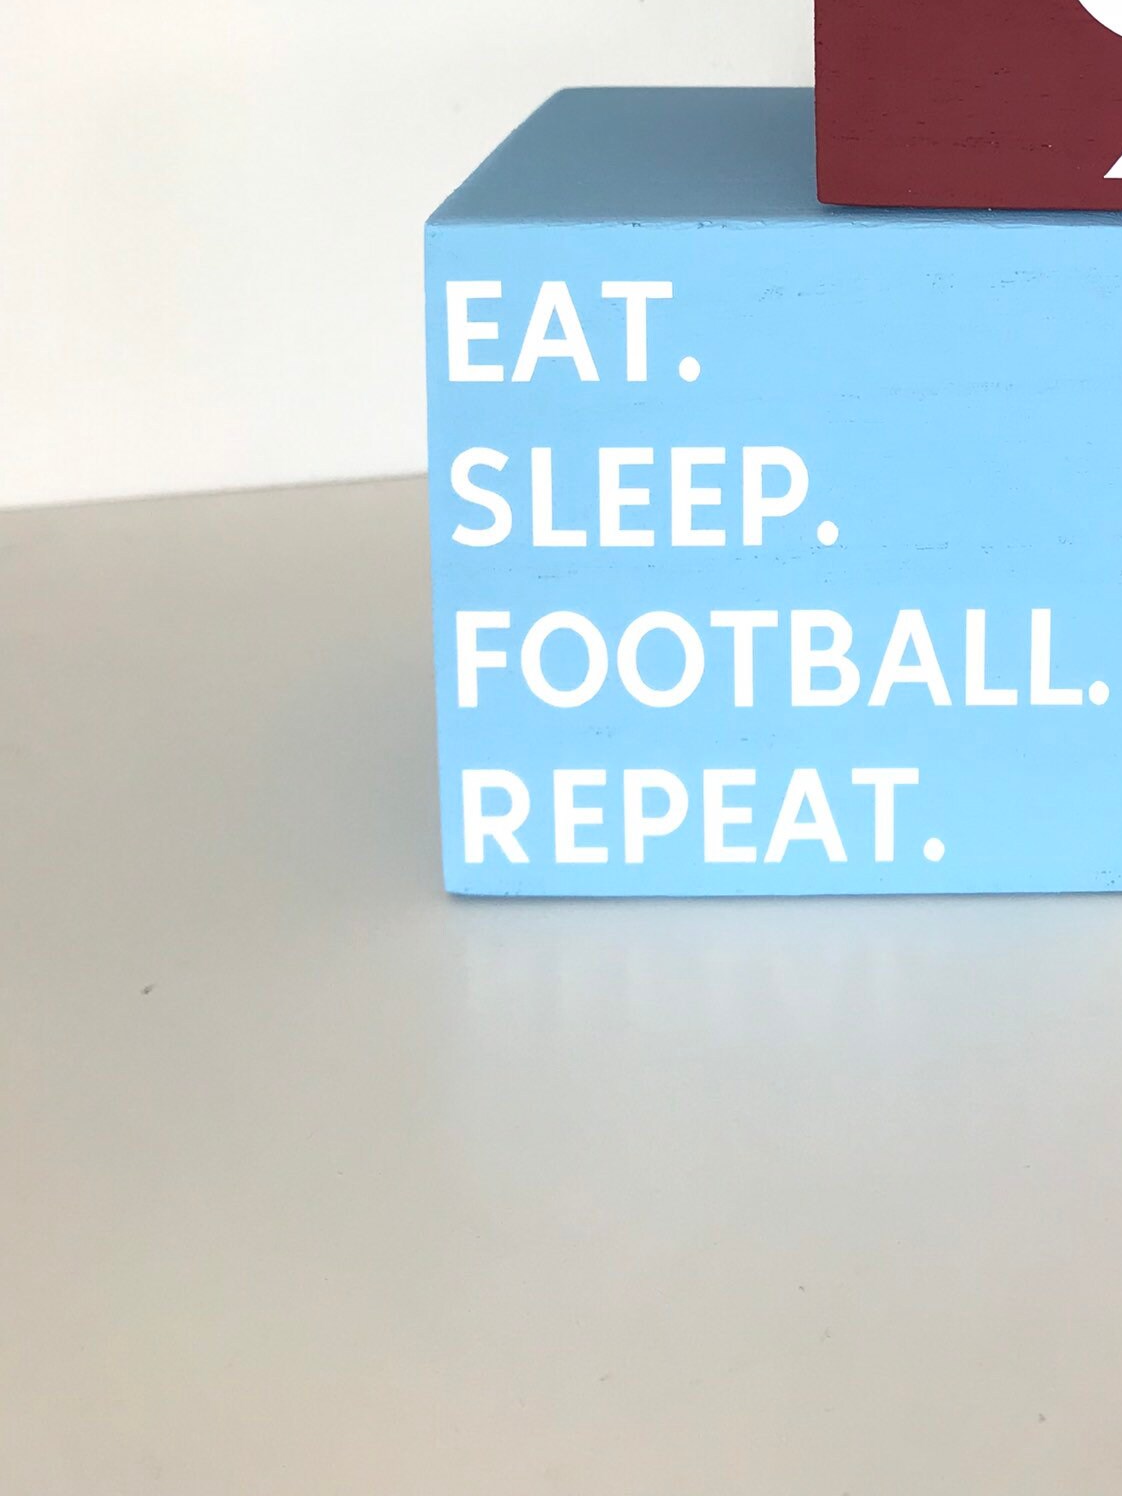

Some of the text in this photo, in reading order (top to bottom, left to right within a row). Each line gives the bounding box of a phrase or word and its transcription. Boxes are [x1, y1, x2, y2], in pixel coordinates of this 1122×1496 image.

[446, 280, 701, 384] EAT.
[450, 445, 840, 548] SLEEP.
[456, 608, 1110, 708] FOOTBALL.
[462, 767, 945, 865] REPEAT.
